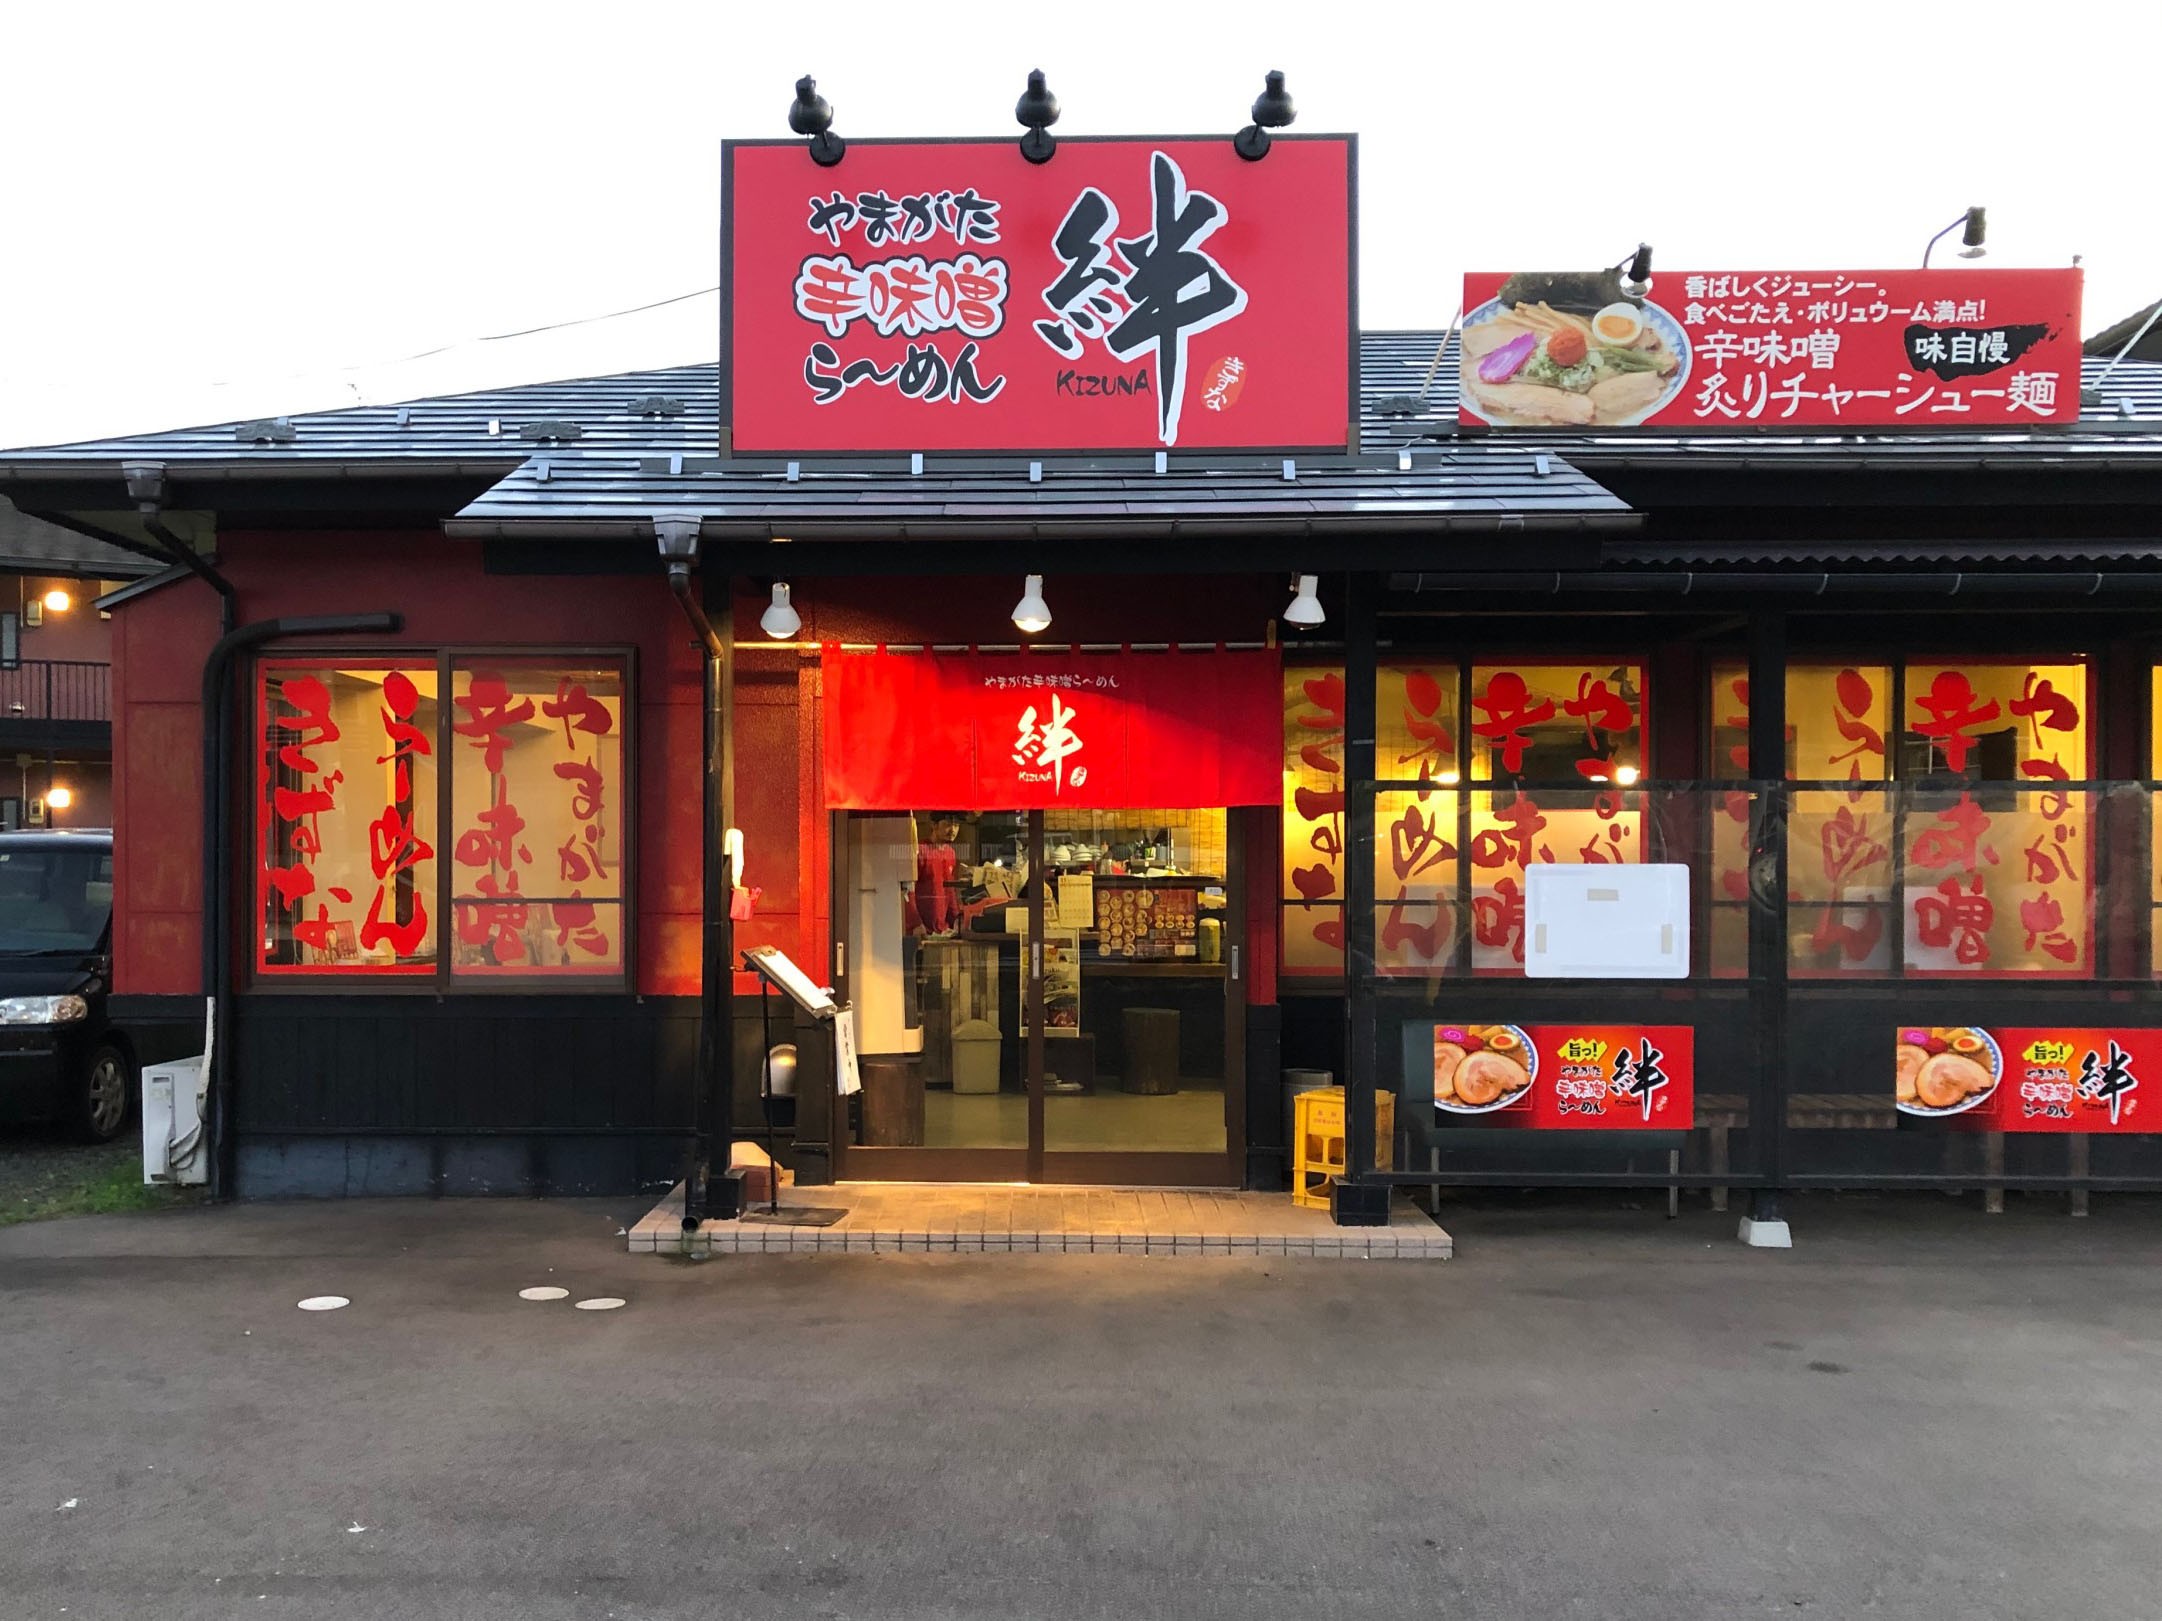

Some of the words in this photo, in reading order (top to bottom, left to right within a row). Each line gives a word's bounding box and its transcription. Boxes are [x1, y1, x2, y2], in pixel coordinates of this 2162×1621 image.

[809, 189, 1001, 246] やまがた
[798, 256, 1006, 335] 辛味噌
[1034, 151, 1248, 445] 絆
[1685, 276, 1887, 299] 香ばしくジューシー。
[1694, 329, 1841, 370] 辛味噌
[1914, 331, 2011, 365] 味自慢
[1056, 369, 1151, 397] KIZUNA
[1694, 370, 2060, 419] 炙りチャーシュー麺
[1012, 693, 1083, 797] 絆
[1018, 771, 1053, 782] KIZUNA
[543, 676, 613, 956] やまがた
[1608, 1037, 1669, 1120] 絆
[2076, 1040, 2138, 1125] 絆
